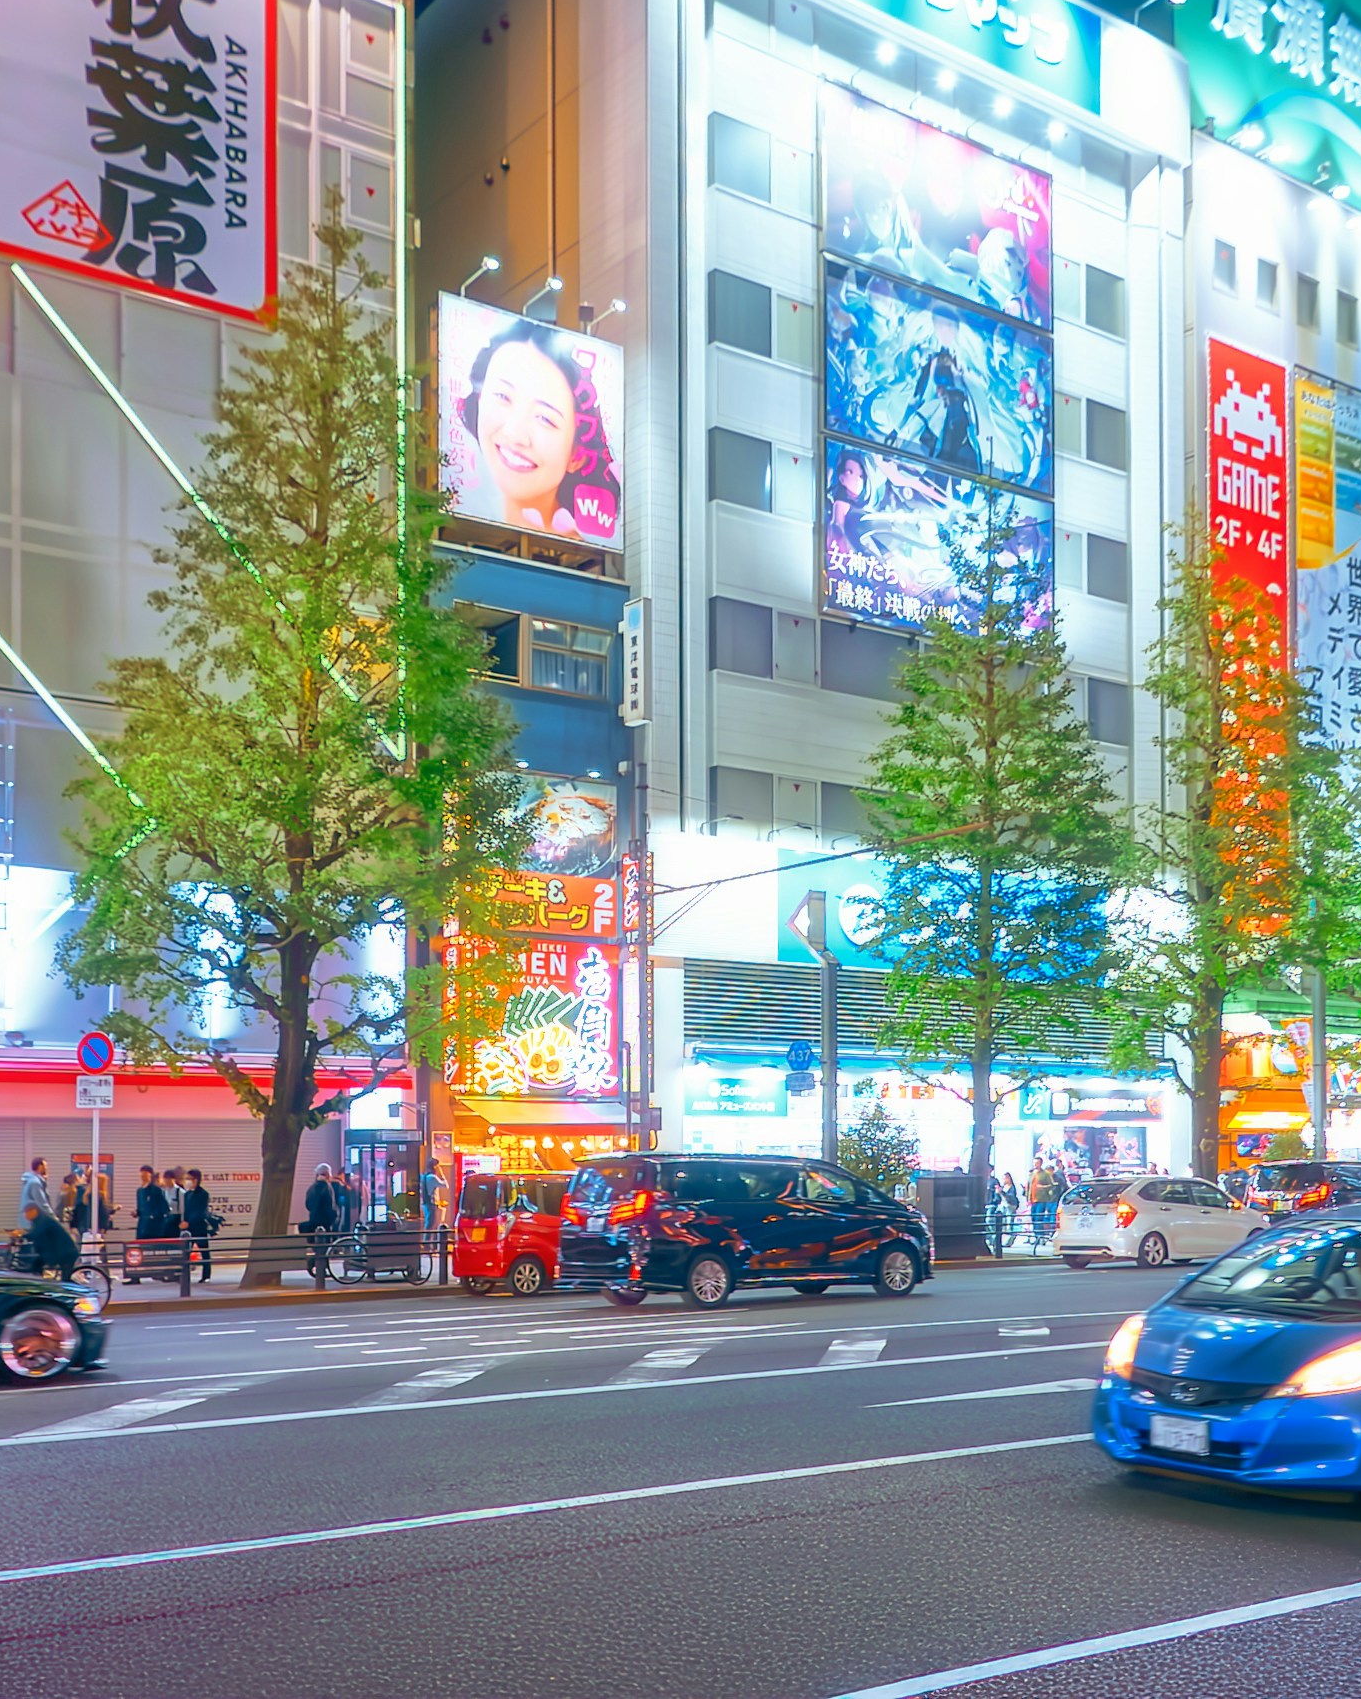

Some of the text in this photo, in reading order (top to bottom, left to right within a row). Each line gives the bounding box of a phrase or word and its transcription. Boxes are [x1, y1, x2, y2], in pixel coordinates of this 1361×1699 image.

[225, 35, 247, 229] AKIHABARA
[1218, 457, 1281, 521] GAME
[1215, 515, 1283, 561] 2F 4F
[789, 1049, 810, 1061] 437
